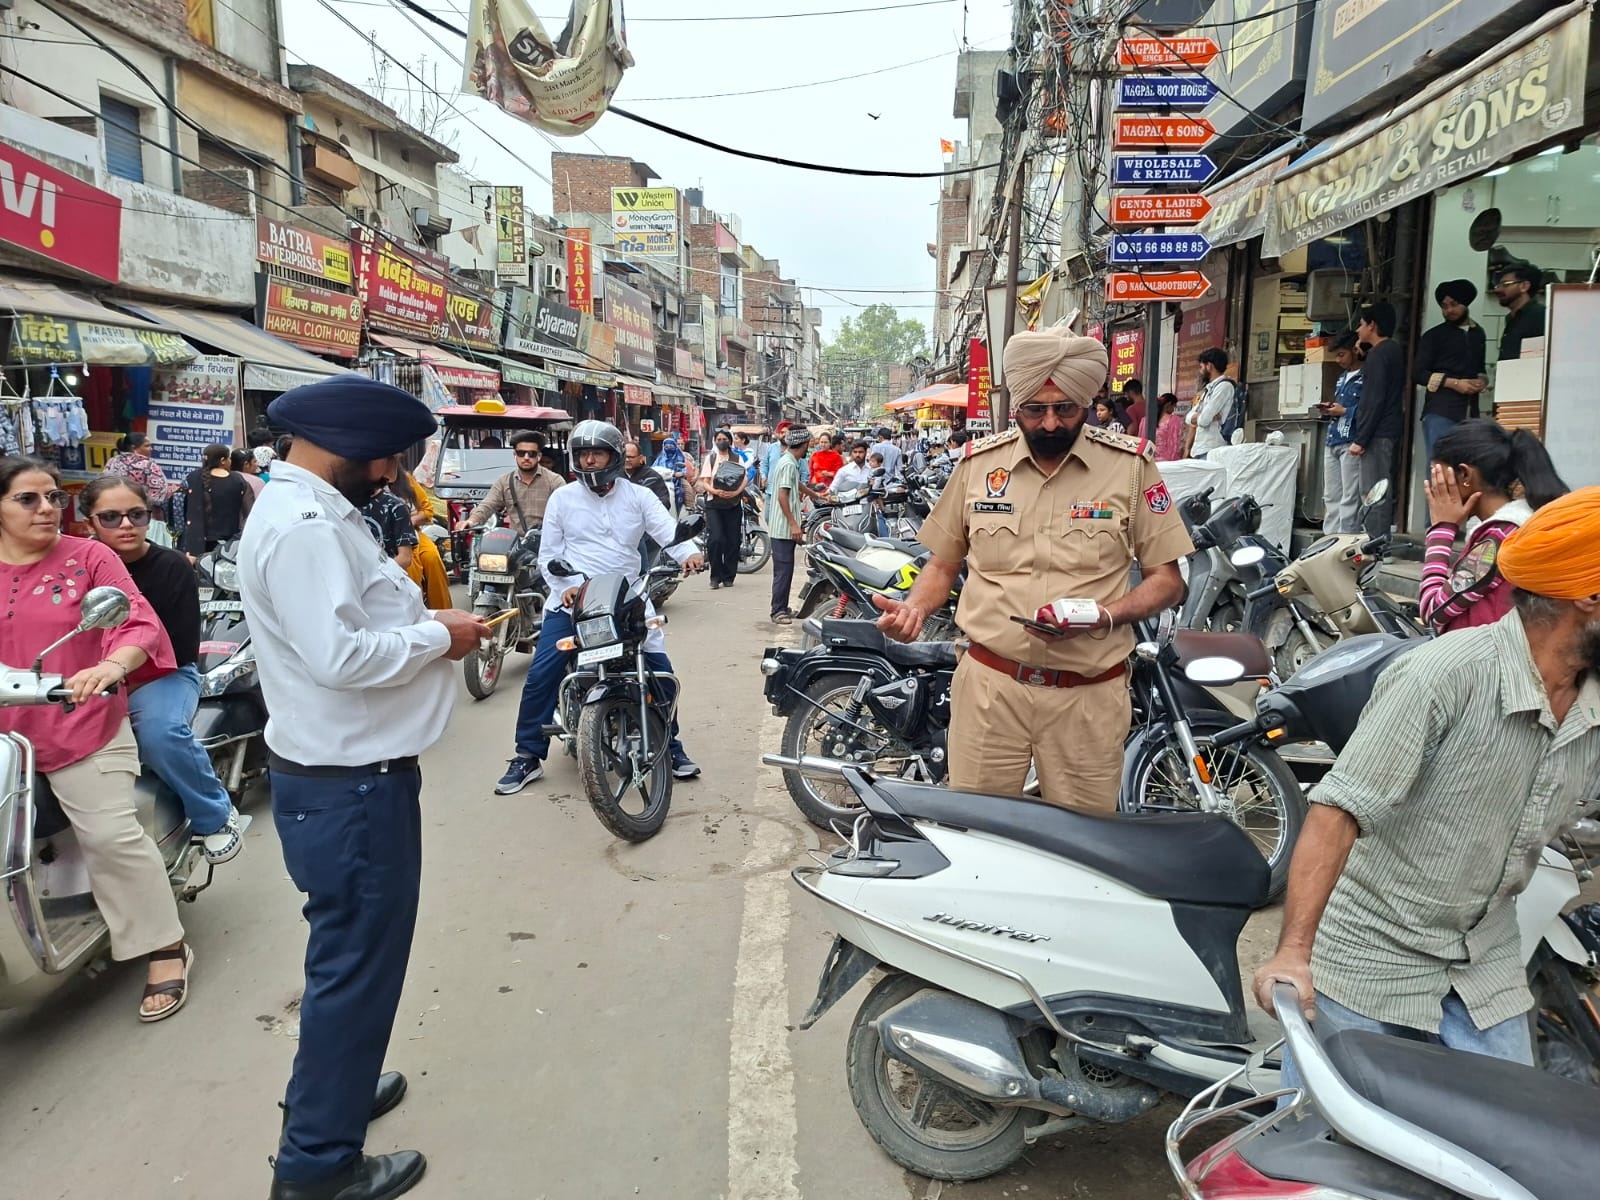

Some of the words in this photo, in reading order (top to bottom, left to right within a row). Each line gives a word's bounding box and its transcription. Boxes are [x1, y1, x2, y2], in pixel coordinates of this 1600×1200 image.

[1122, 43, 1160, 55] NAGPAL
[1176, 42, 1207, 54] HATTI
[1142, 54, 1163, 62] SINCE
[1124, 85, 1155, 96] NAGPAL
[1157, 85, 1178, 96] BOOT
[1180, 85, 1207, 96] HOUSE
[1123, 125, 1163, 137] NAGPAL
[1166, 125, 1173, 137] &
[1176, 125, 1205, 137] SONS
[1280, 157, 1386, 236] NAGPAL
[1390, 140, 1420, 182] &
[1431, 63, 1550, 166] SONS
[1123, 159, 1202, 168] WHOLESALE
[1132, 170, 1140, 179] &
[1145, 170, 1191, 179] RETAIL
[640, 191, 673, 201] Western
[1295, 222, 1323, 242] DEALS
[1325, 217, 1336, 231] IN
[1345, 180, 1421, 217] WHOLESALE
[1423, 174, 1431, 186] &
[1437, 147, 1492, 178] RETAIL
[640, 199, 664, 208] Union
[1119, 200, 1153, 209] GENTS
[1155, 199, 1163, 209] &
[1165, 199, 1203, 208] LADIES
[628, 213, 674, 223] MoneyGram
[1129, 209, 1192, 219] FOOTWEARS
[269, 222, 314, 256] BATRA
[646, 234, 672, 244] MONEY
[646, 243, 675, 252] TRANSFER
[259, 240, 324, 273] ENTERPRISES
[351, 305, 360, 317] 26
[267, 314, 301, 335] HARPAL
[304, 322, 332, 340] CLOTH
[334, 327, 360, 346] HOUSE
[1190, 320, 1211, 337] NOTE
